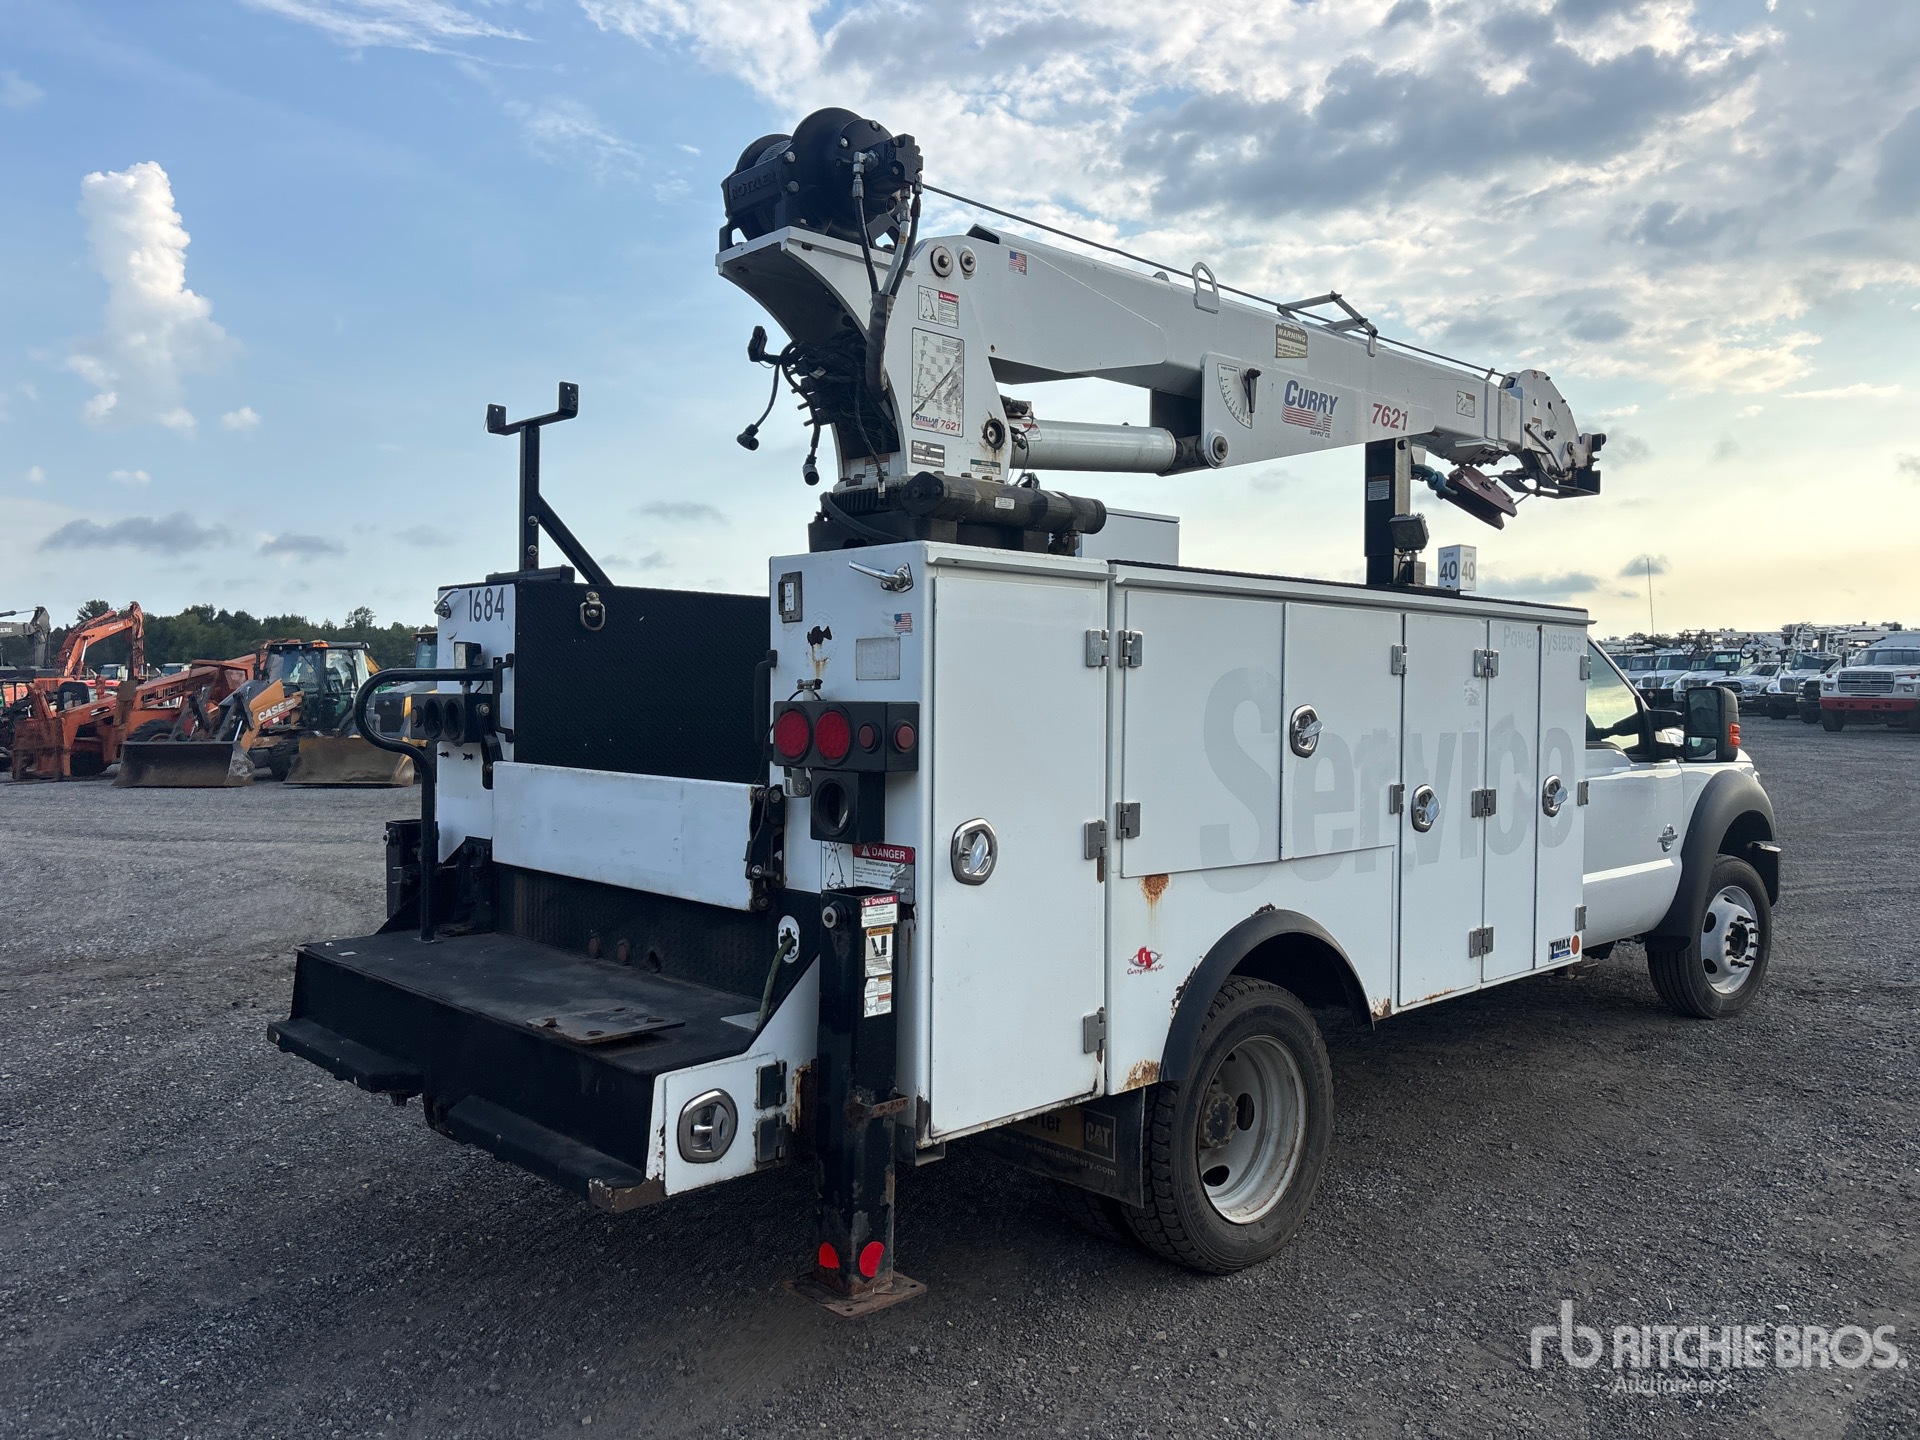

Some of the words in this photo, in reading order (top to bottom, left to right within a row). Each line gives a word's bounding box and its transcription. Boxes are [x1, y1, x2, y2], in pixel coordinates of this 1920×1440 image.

[1277, 328, 1306, 343] WARNING
[1284, 380, 1338, 415] CURRY
[915, 412, 939, 425] STELLAR
[940, 419, 961, 431] 7621
[1371, 403, 1408, 431] 7621
[1310, 429, 1324, 437] SUPPLY
[1440, 560, 1458, 581] 40
[1461, 561, 1475, 581] 40
[469, 587, 504, 622] 1684
[1503, 624, 1538, 649] Power
[258, 702, 284, 721] CASE
[1200, 666, 1575, 893] Service
[871, 847, 906, 860] DANGER
[871, 896, 894, 905] DANGER
[1026, 1112, 1062, 1133] arter
[1085, 1121, 1112, 1149] CAT
